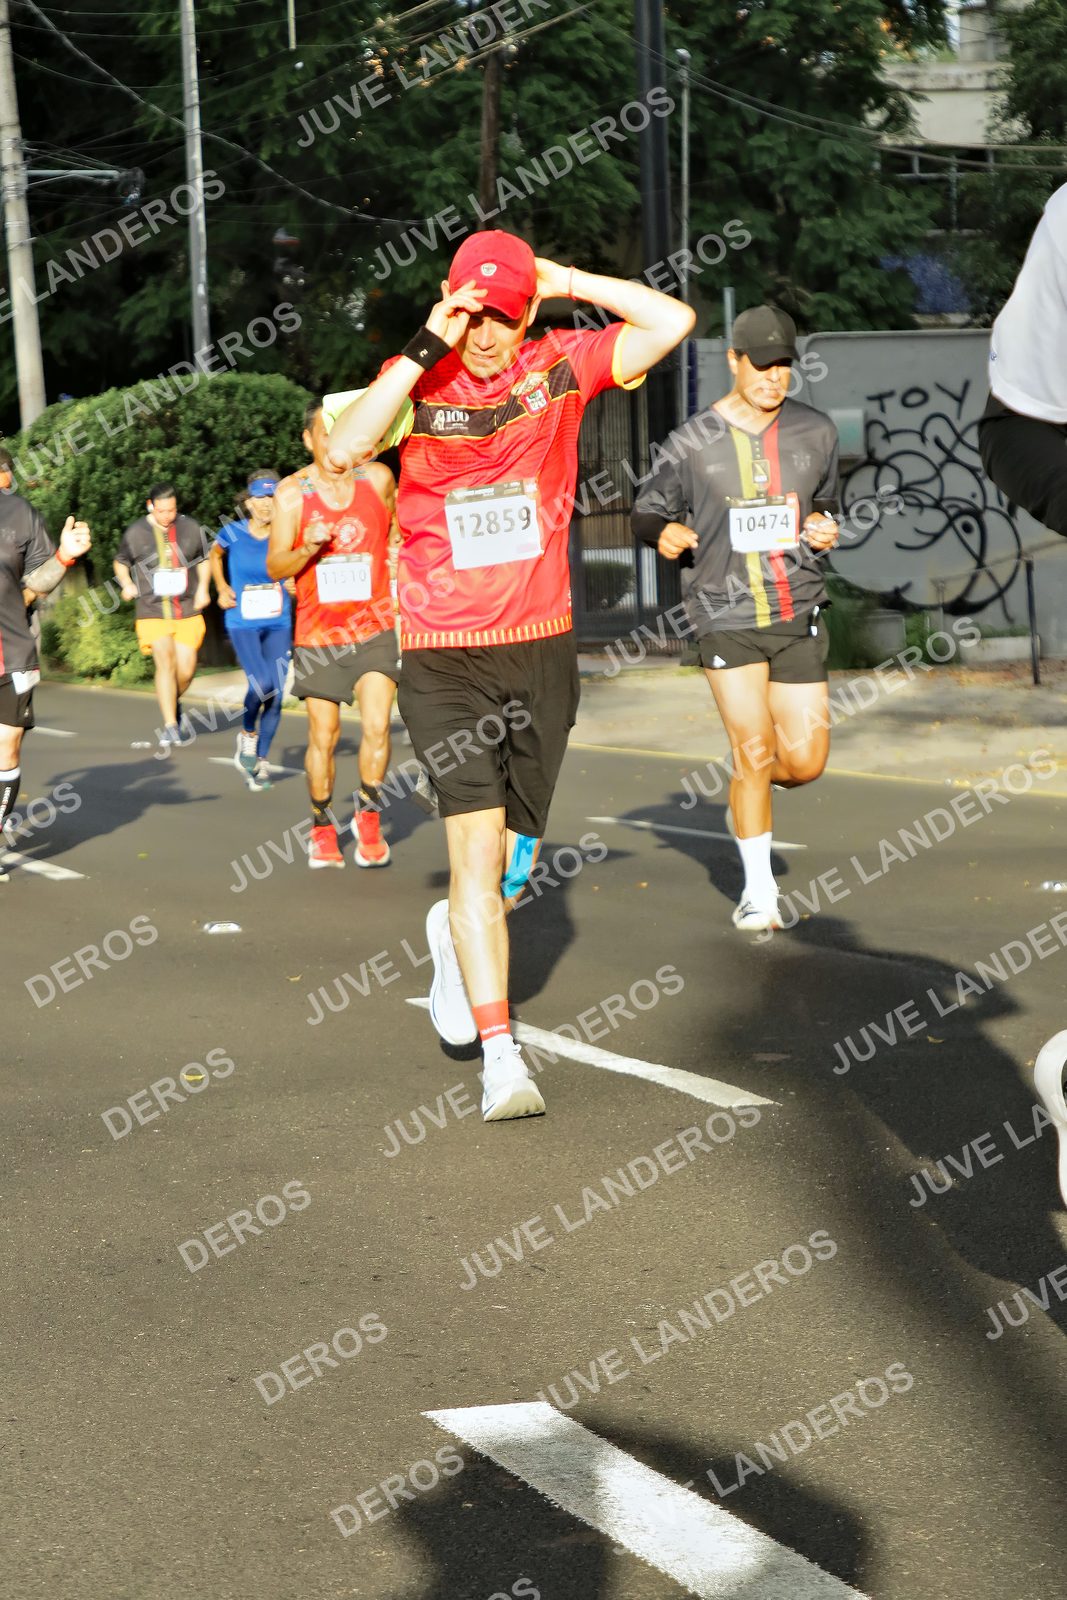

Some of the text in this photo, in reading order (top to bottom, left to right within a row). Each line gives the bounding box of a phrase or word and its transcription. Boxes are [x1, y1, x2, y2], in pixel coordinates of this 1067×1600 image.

[866, 379, 971, 420] TOY
[445, 410, 469, 423] 100
[454, 506, 531, 538] 12859
[736, 513, 790, 533] 10474
